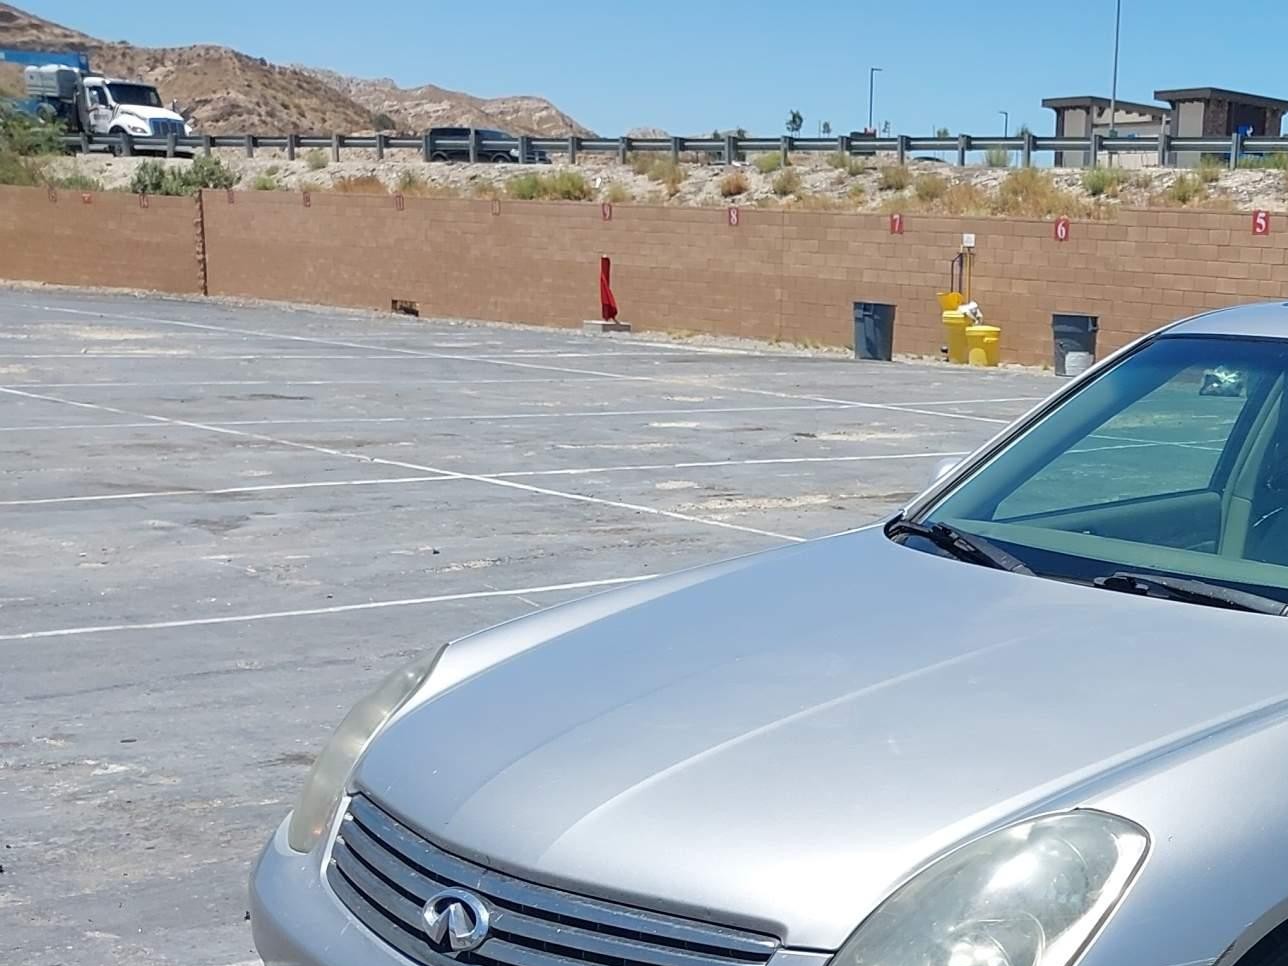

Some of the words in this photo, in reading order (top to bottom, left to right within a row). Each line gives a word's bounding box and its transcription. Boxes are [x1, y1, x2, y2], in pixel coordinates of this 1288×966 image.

[730, 208, 738, 225] 8
[893, 214, 900, 232] 7
[1256, 211, 1266, 232] 5
[1057, 221, 1066, 239] 6
